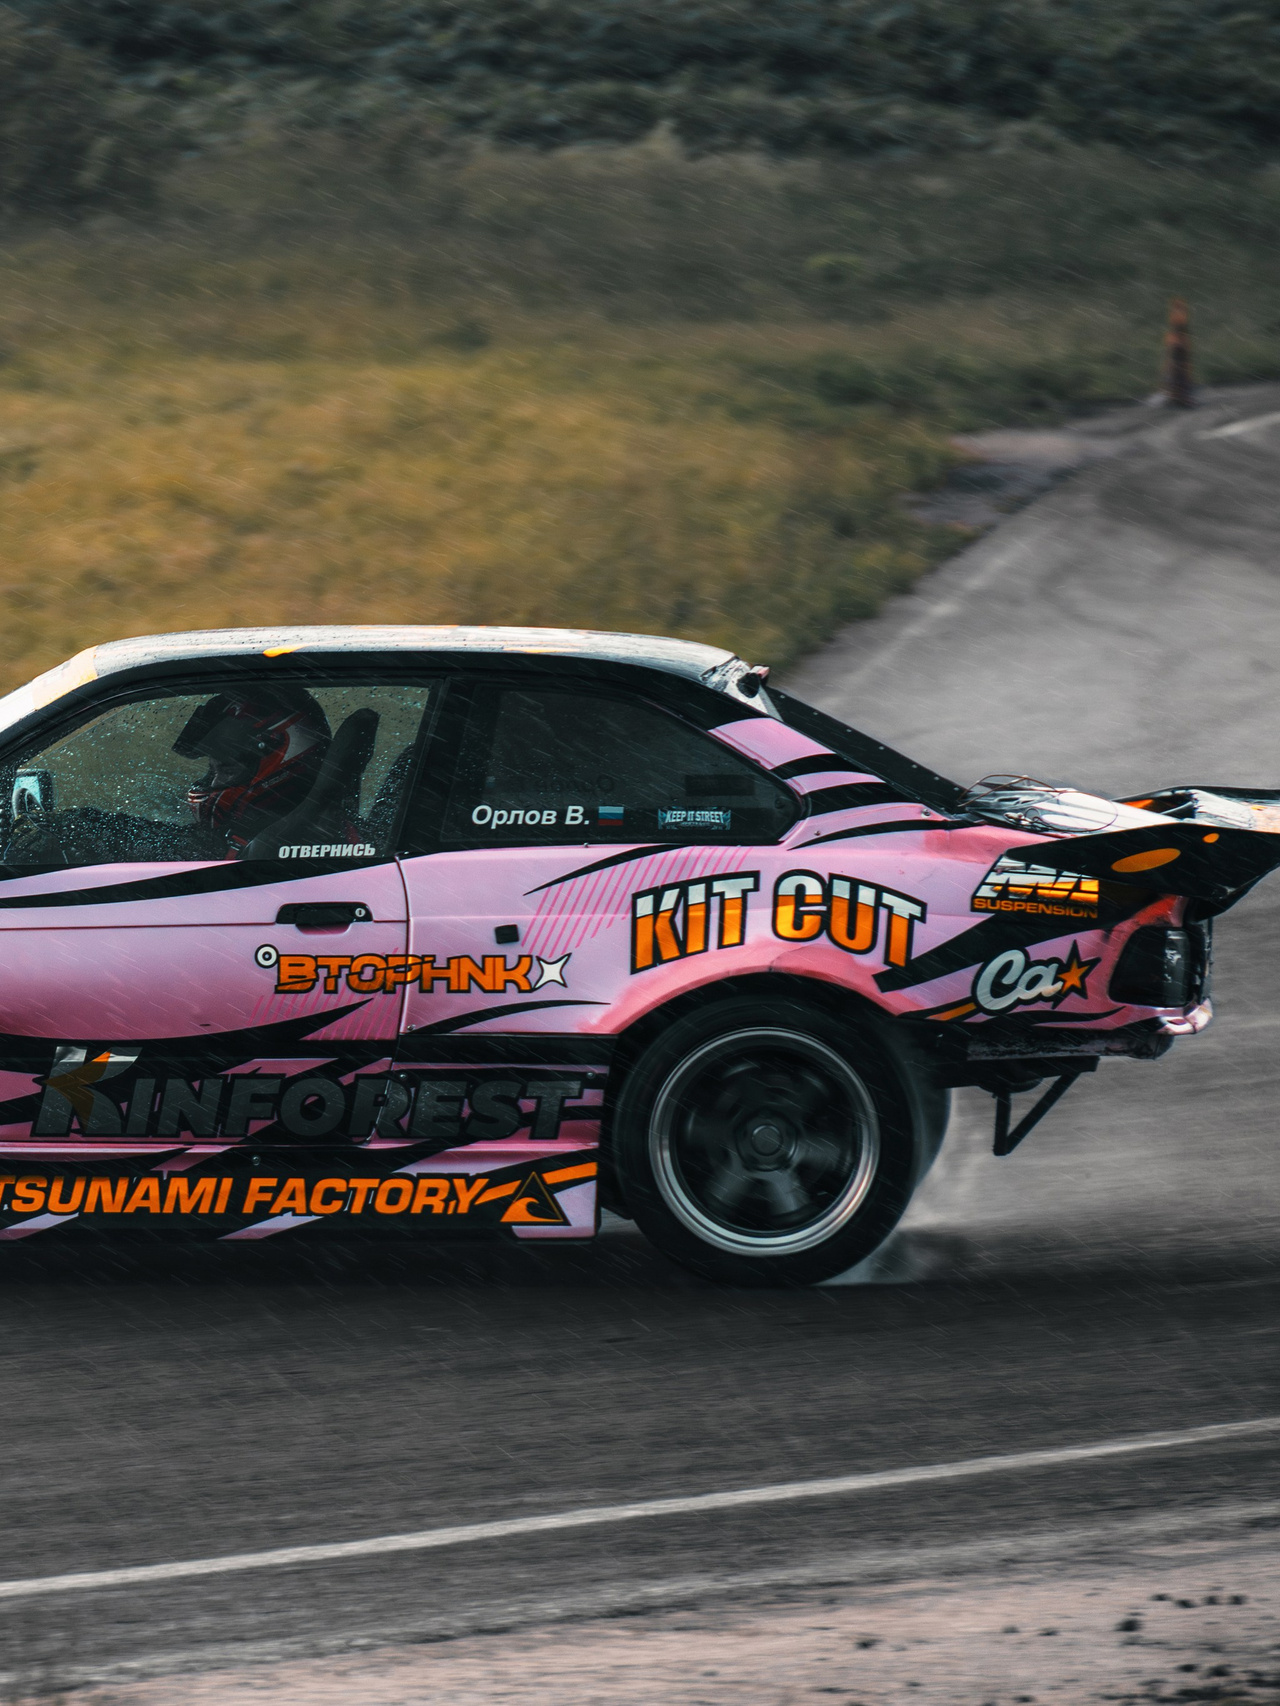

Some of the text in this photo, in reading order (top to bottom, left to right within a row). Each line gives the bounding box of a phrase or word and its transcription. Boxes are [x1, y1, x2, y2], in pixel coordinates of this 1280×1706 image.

[472, 805, 590, 829] Орлов В.
[665, 810, 724, 823] KEEP IT STREET
[278, 844, 376, 858] ОТВЕРНИСЬ
[973, 898, 1098, 918] SUSPENSION
[631, 870, 760, 974] KIT
[772, 869, 927, 968] CUT
[30, 1046, 585, 1140] KINFOREST
[242, 1176, 490, 1215] FACTORY
